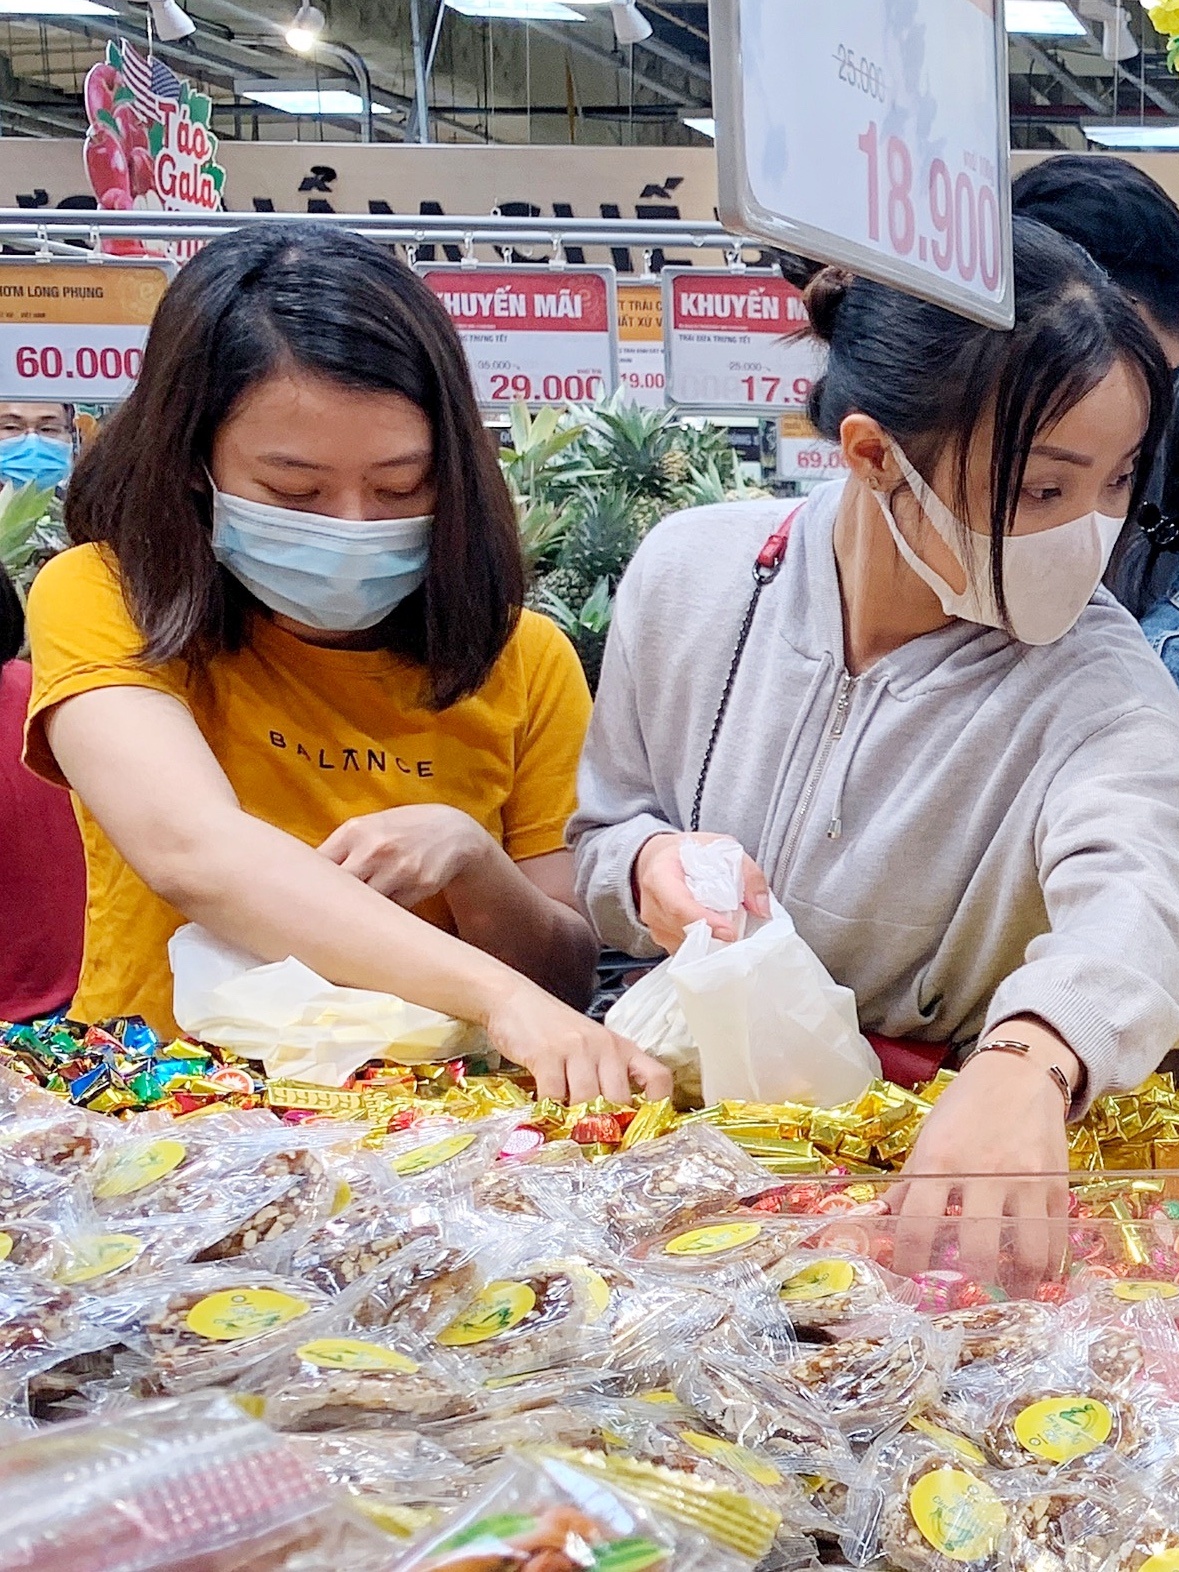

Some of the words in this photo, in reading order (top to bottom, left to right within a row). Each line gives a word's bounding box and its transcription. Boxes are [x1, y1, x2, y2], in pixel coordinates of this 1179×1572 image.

[157, 101, 212, 159] Táo
[157, 153, 219, 210] Gala
[857, 120, 1002, 292] 18.900
[28, 286, 60, 298] LONG
[533, 289, 583, 319] MÃI
[679, 287, 780, 320] KHUYẾN
[16, 346, 143, 380] 60.000
